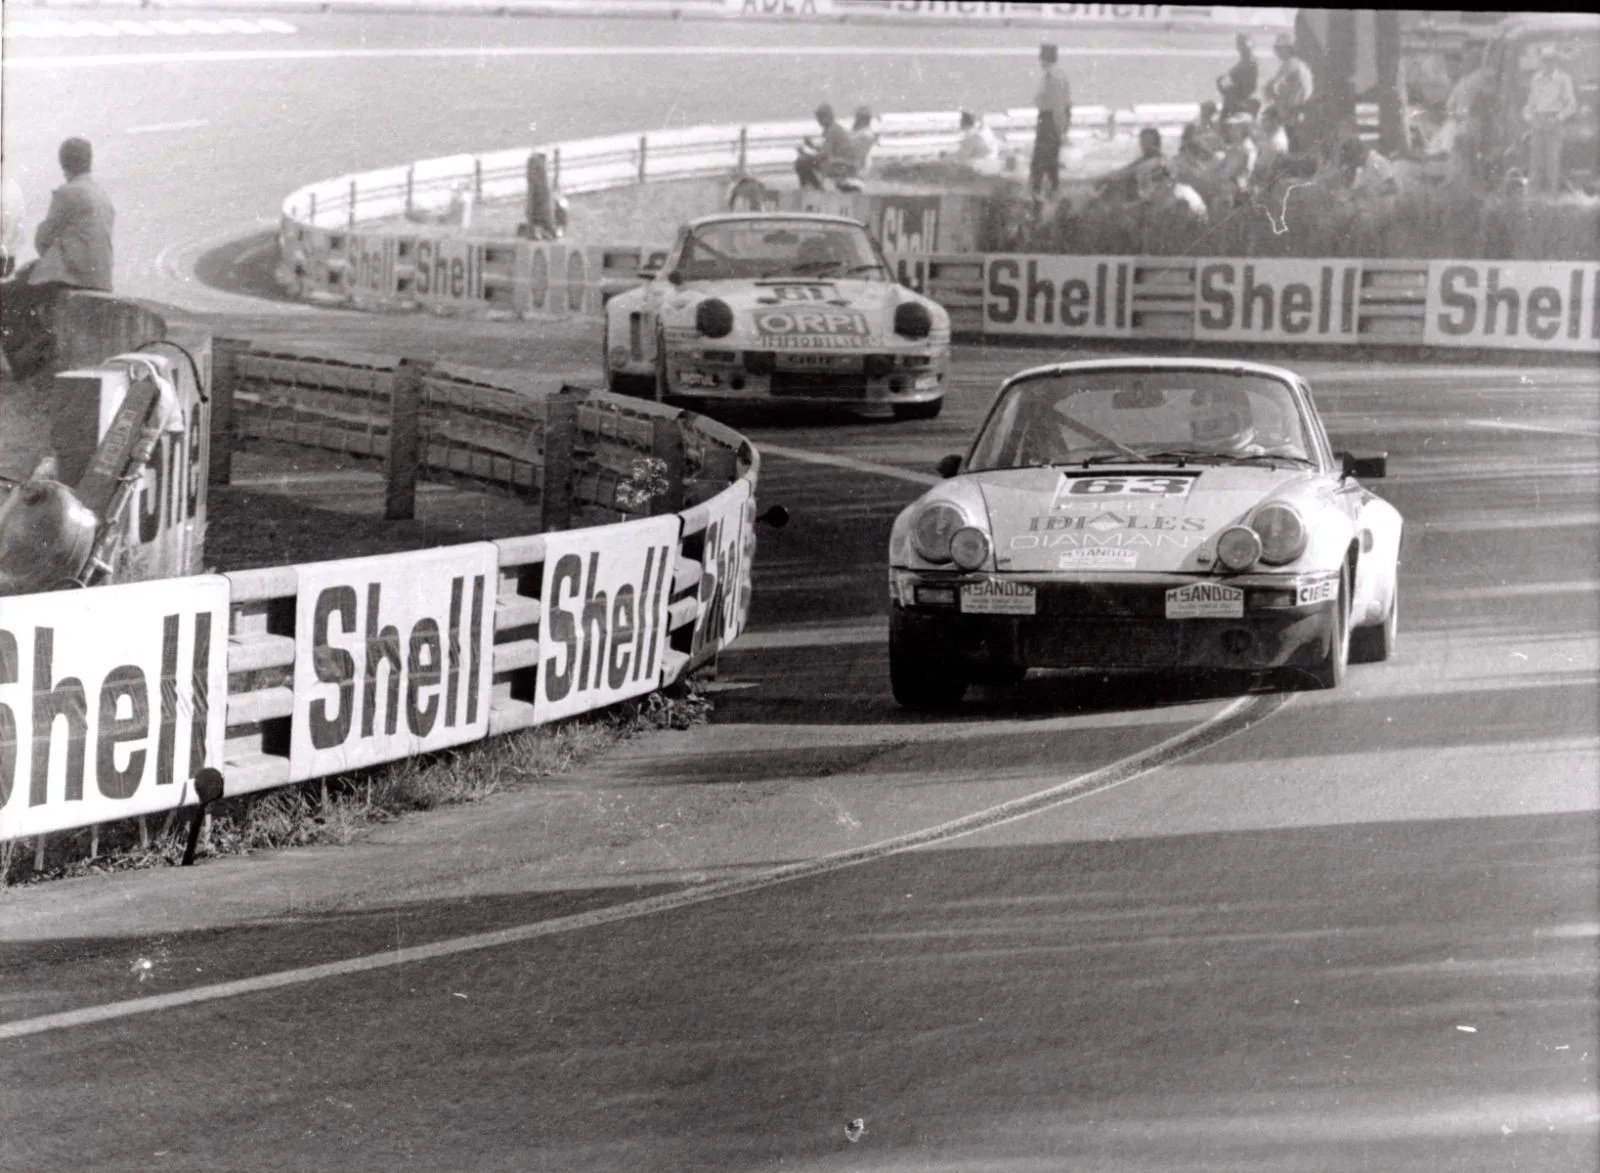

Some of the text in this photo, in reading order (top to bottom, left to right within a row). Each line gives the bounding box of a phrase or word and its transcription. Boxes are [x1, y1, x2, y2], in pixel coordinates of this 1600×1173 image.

[416, 240, 484, 300] Shell
[987, 257, 1129, 328] Shell
[1198, 262, 1359, 335] Shell
[759, 312, 866, 335] ORPI
[1069, 477, 1190, 495] 63
[1010, 532, 1208, 549] DIAMANT
[546, 544, 669, 701] Shell
[1180, 585, 1242, 602] SANDOZ
[310, 574, 485, 750] Shell
